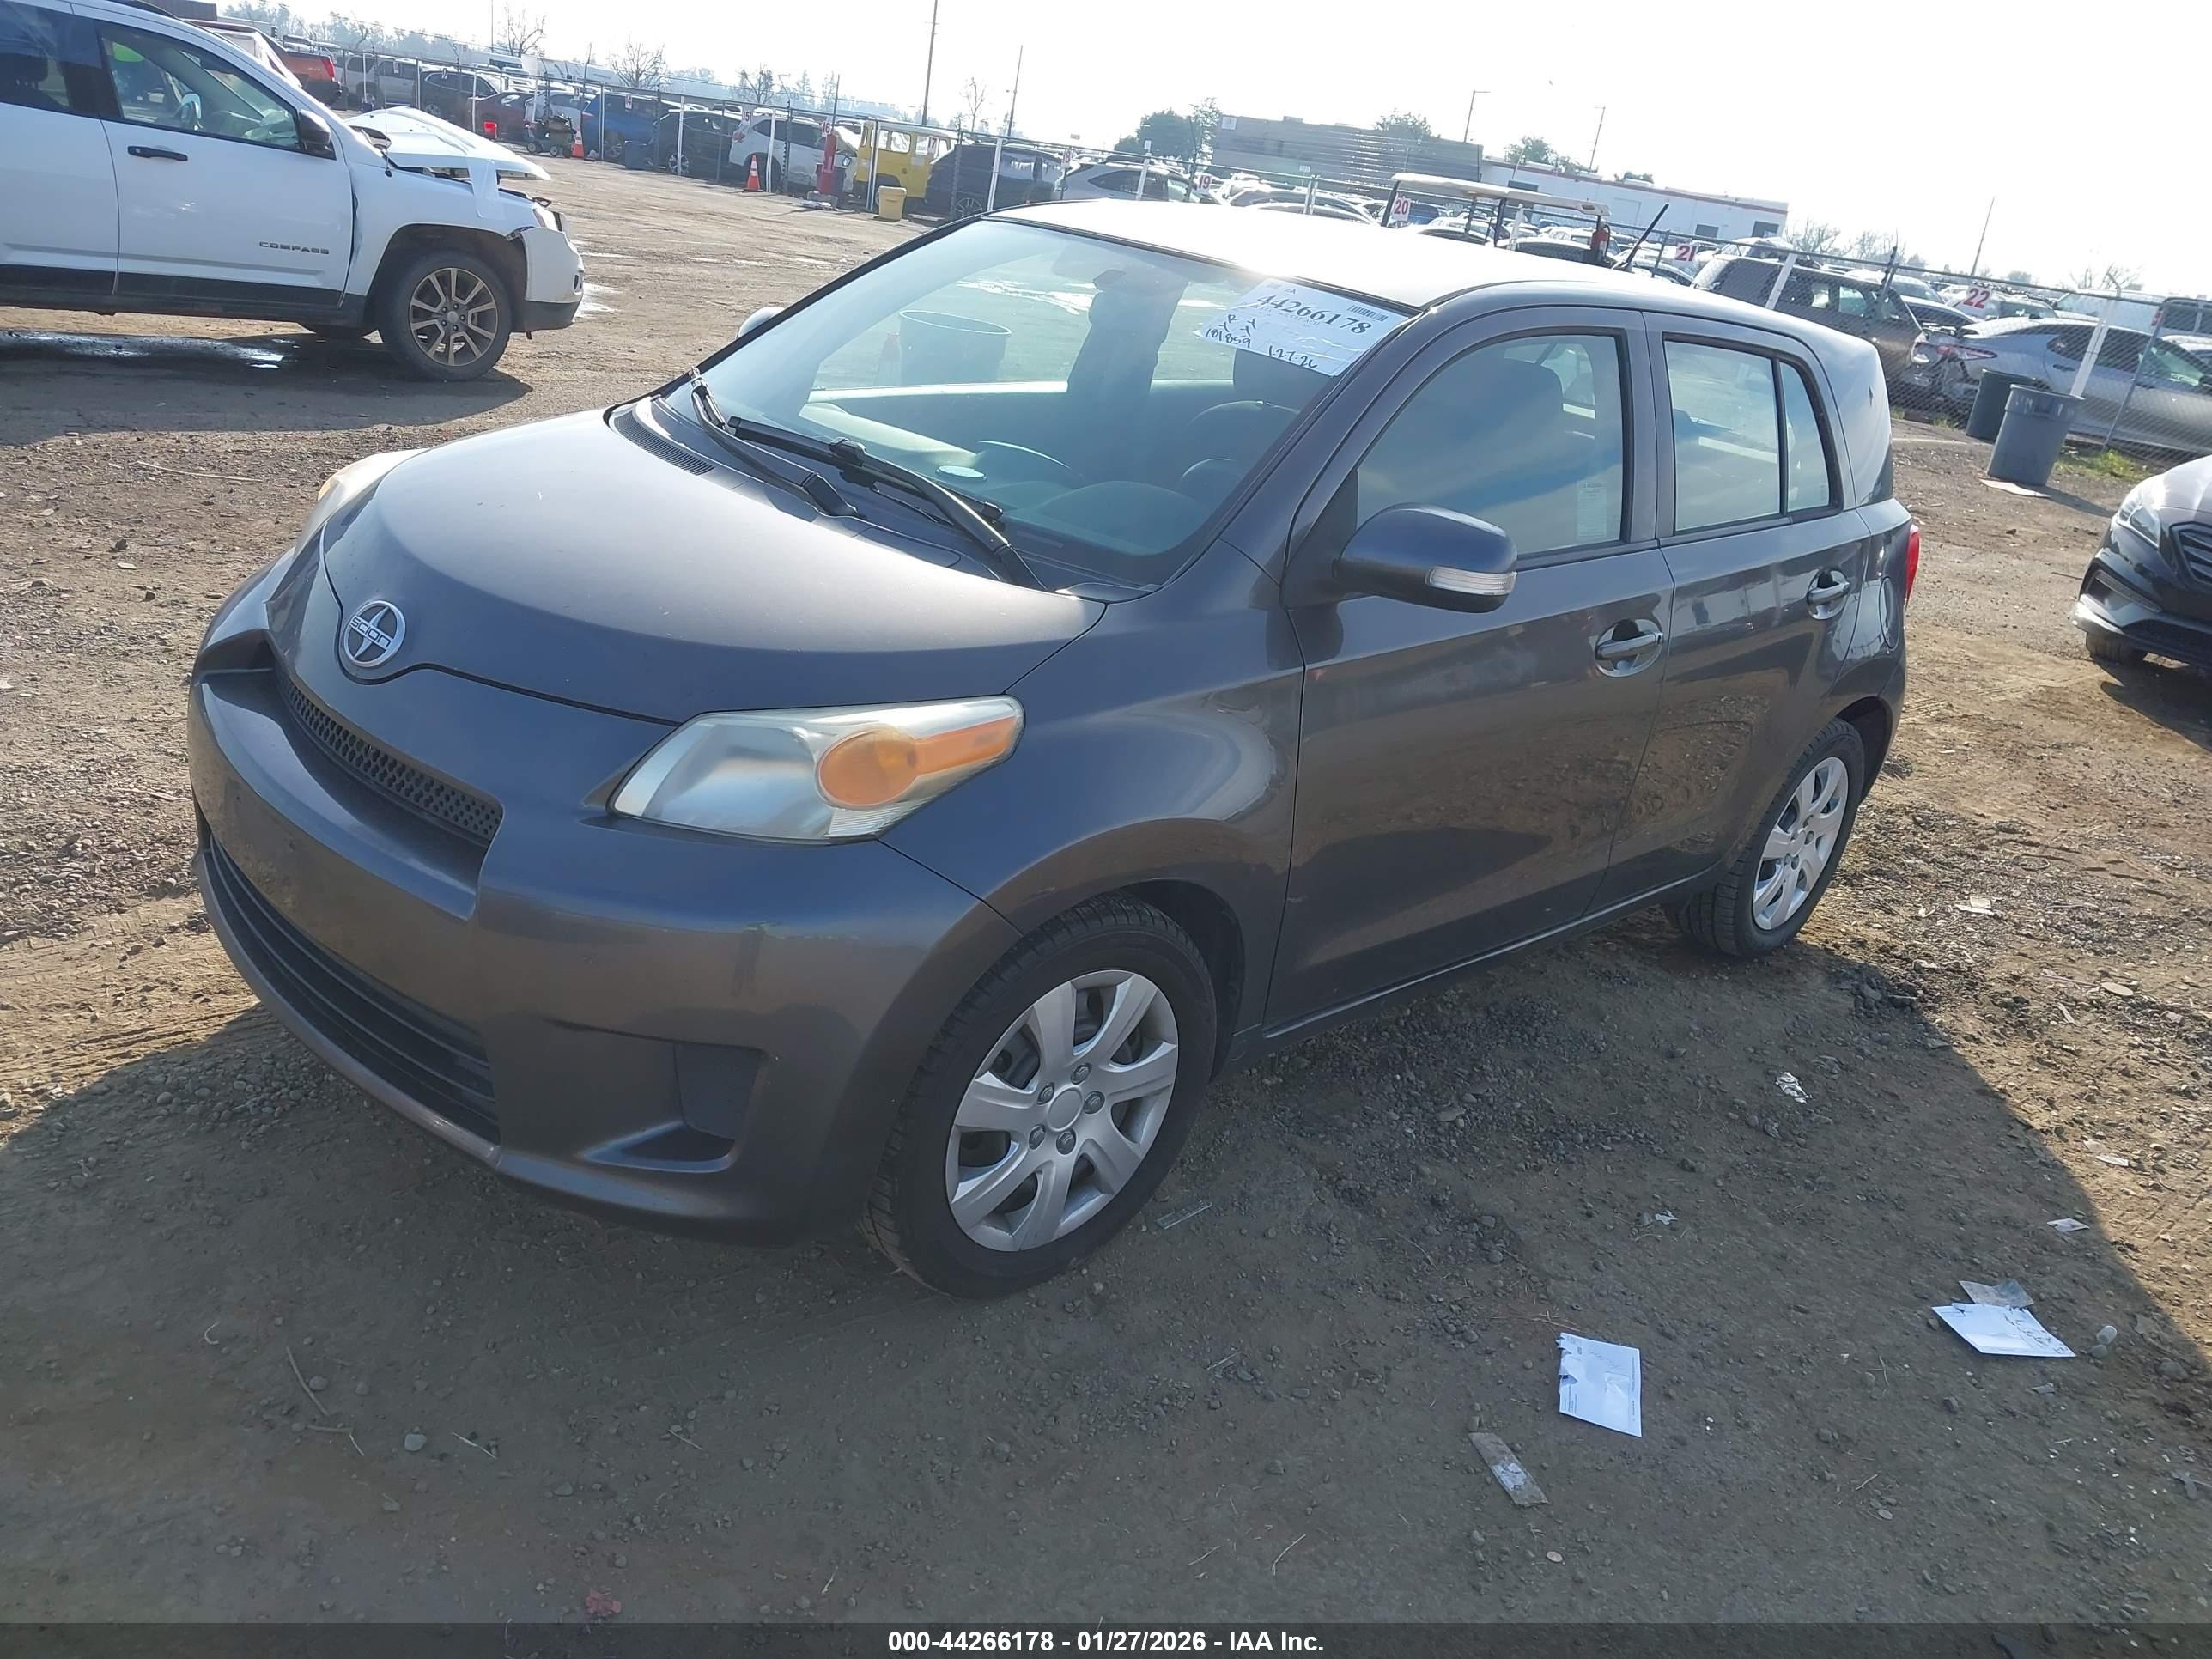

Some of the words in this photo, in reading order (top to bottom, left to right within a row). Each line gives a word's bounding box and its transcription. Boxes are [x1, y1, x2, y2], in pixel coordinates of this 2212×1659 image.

[928, 136, 937, 149] 17
[1198, 174, 1211, 191] 19
[1393, 199, 1409, 215] 20
[258, 240, 330, 255] COMPASS
[1675, 244, 1697, 262] 21
[1962, 287, 1991, 309] 22
[1257, 295, 1372, 335] 44266178
